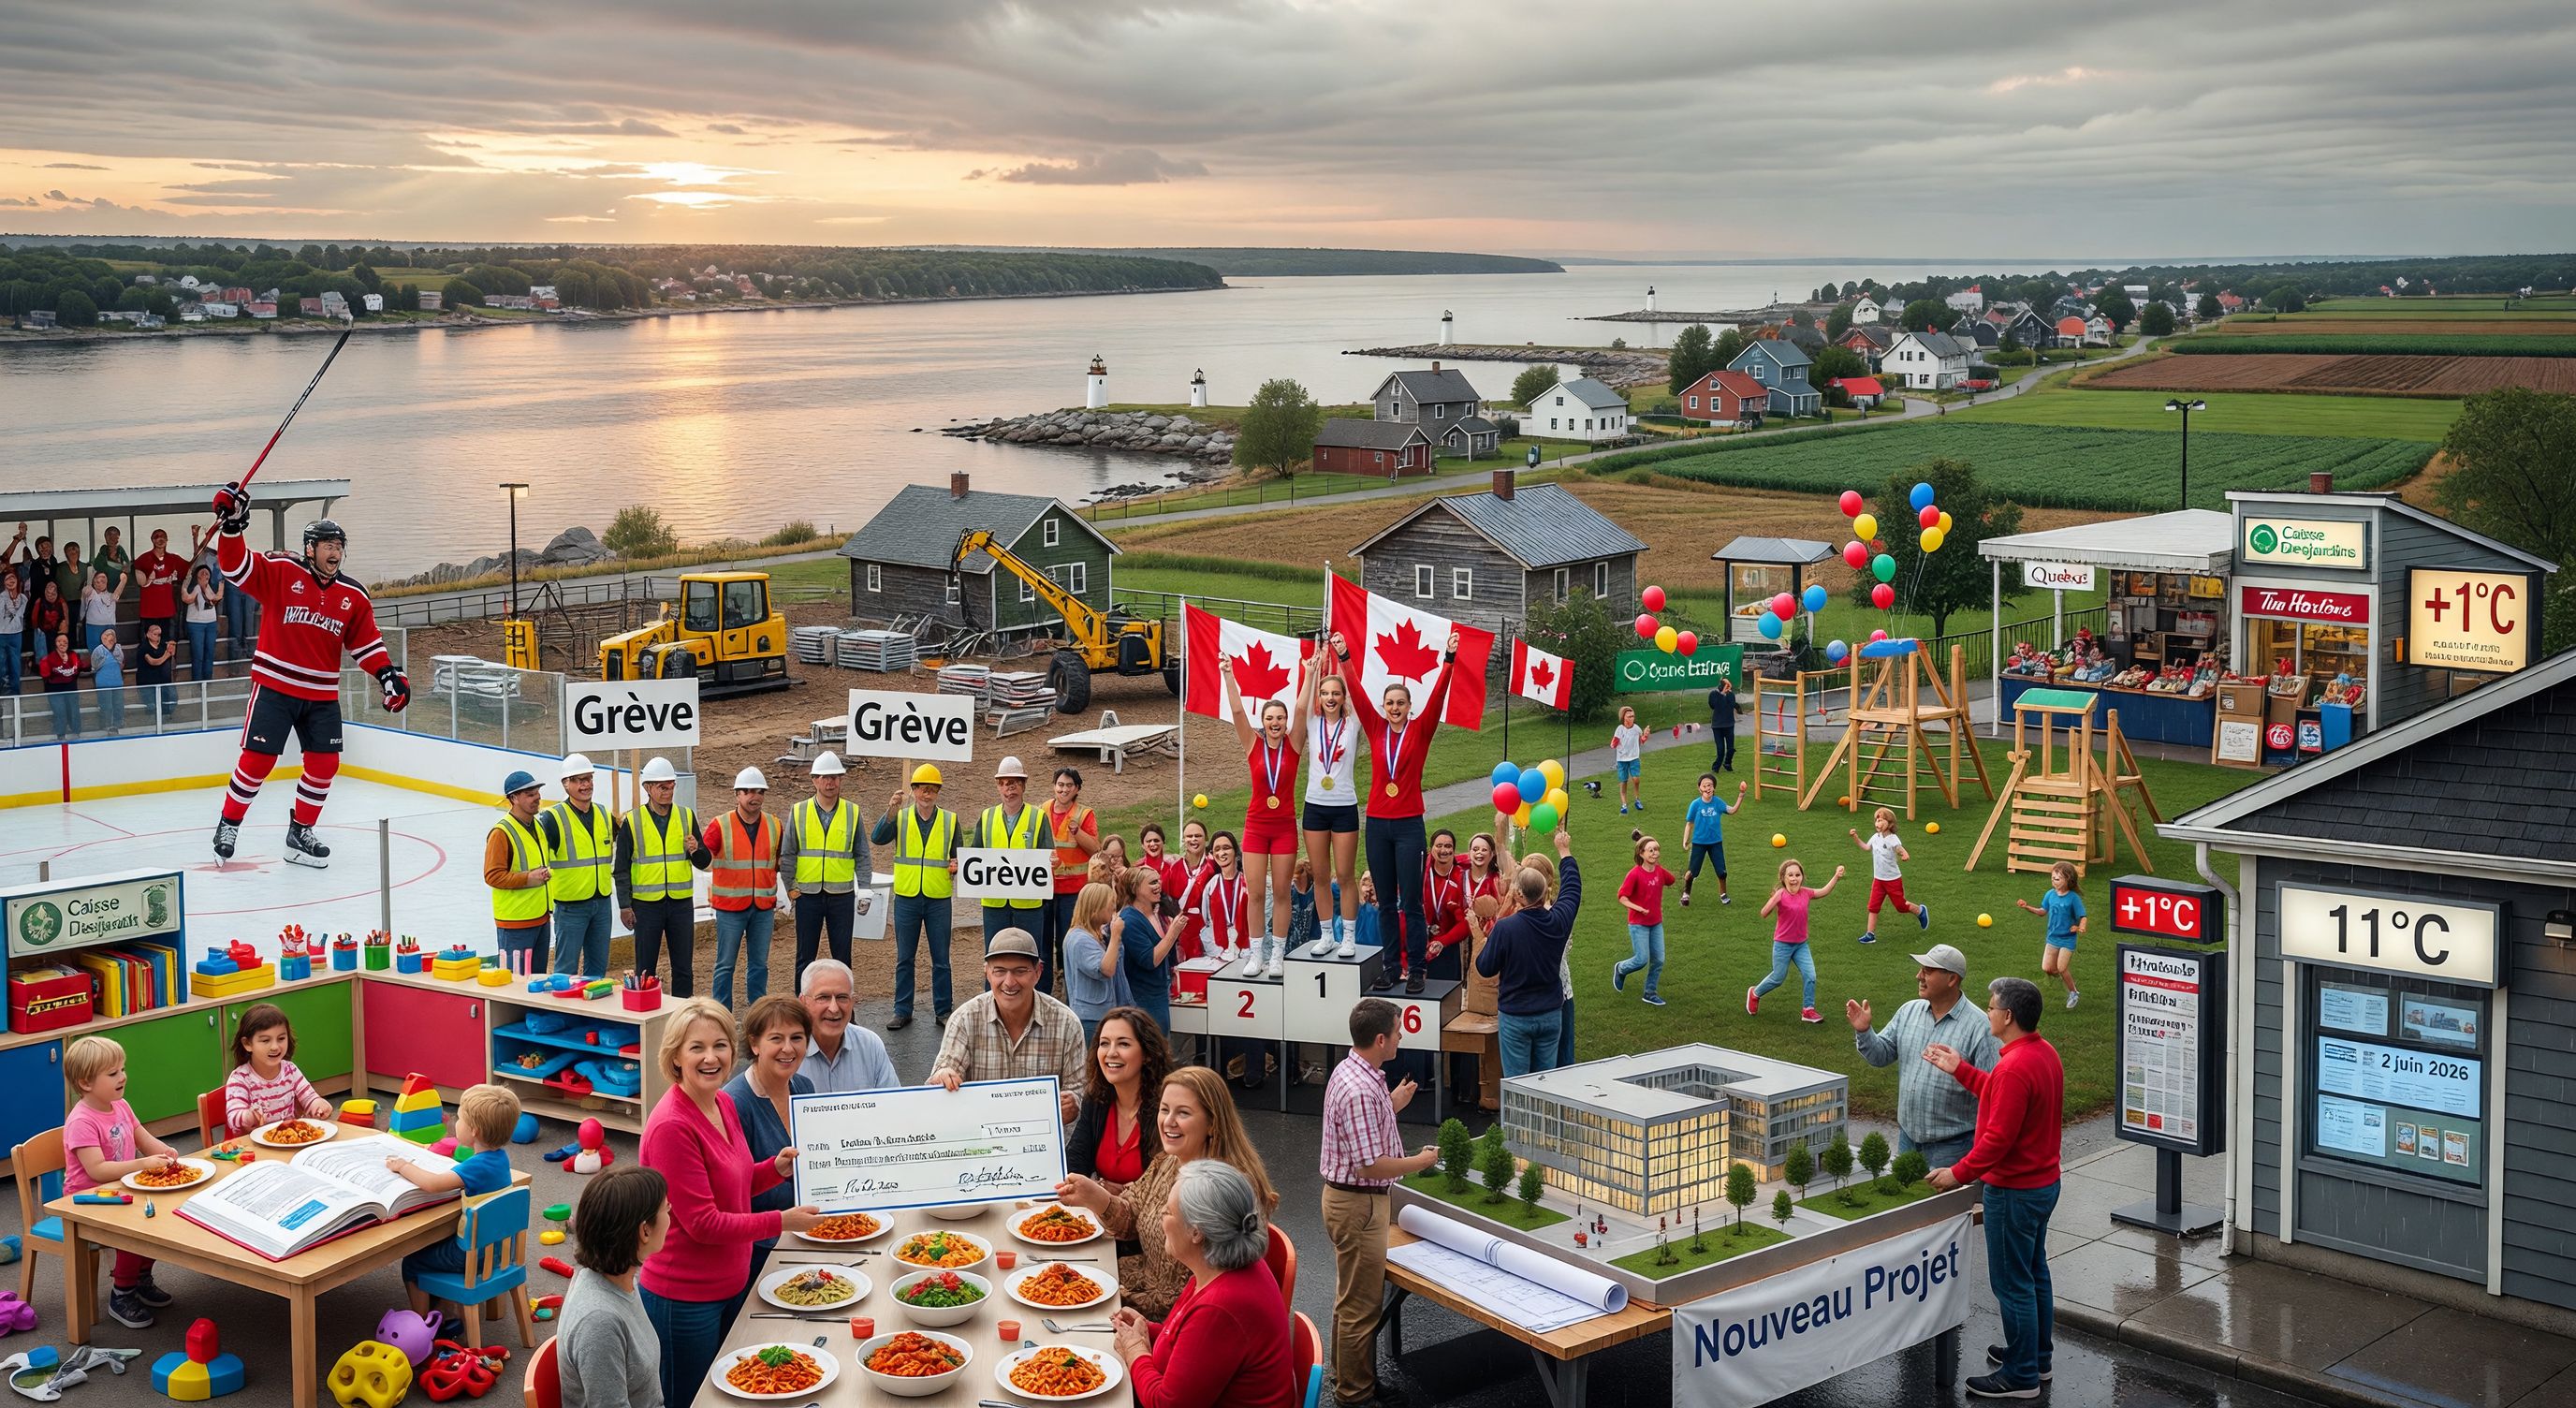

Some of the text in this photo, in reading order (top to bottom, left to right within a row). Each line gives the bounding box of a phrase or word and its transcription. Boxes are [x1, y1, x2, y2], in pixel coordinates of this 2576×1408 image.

[2425, 582, 2515, 635] +1°C
[574, 692, 694, 735] Grève
[855, 701, 968, 745] Grève
[962, 856, 1048, 887] Grève
[67, 898, 120, 917] Caisse
[2121, 896, 2194, 931] +1°C
[2329, 904, 2450, 966] 11°C
[1314, 971, 1326, 998] 1
[1237, 990, 1255, 1019] 2
[1402, 1005, 1422, 1034] 6
[2381, 1053, 2391, 1069] 2
[2393, 1055, 2423, 1074] juin
[2428, 1060, 2469, 1081] 2026
[1694, 1241, 1960, 1368] Nouveau Projet
